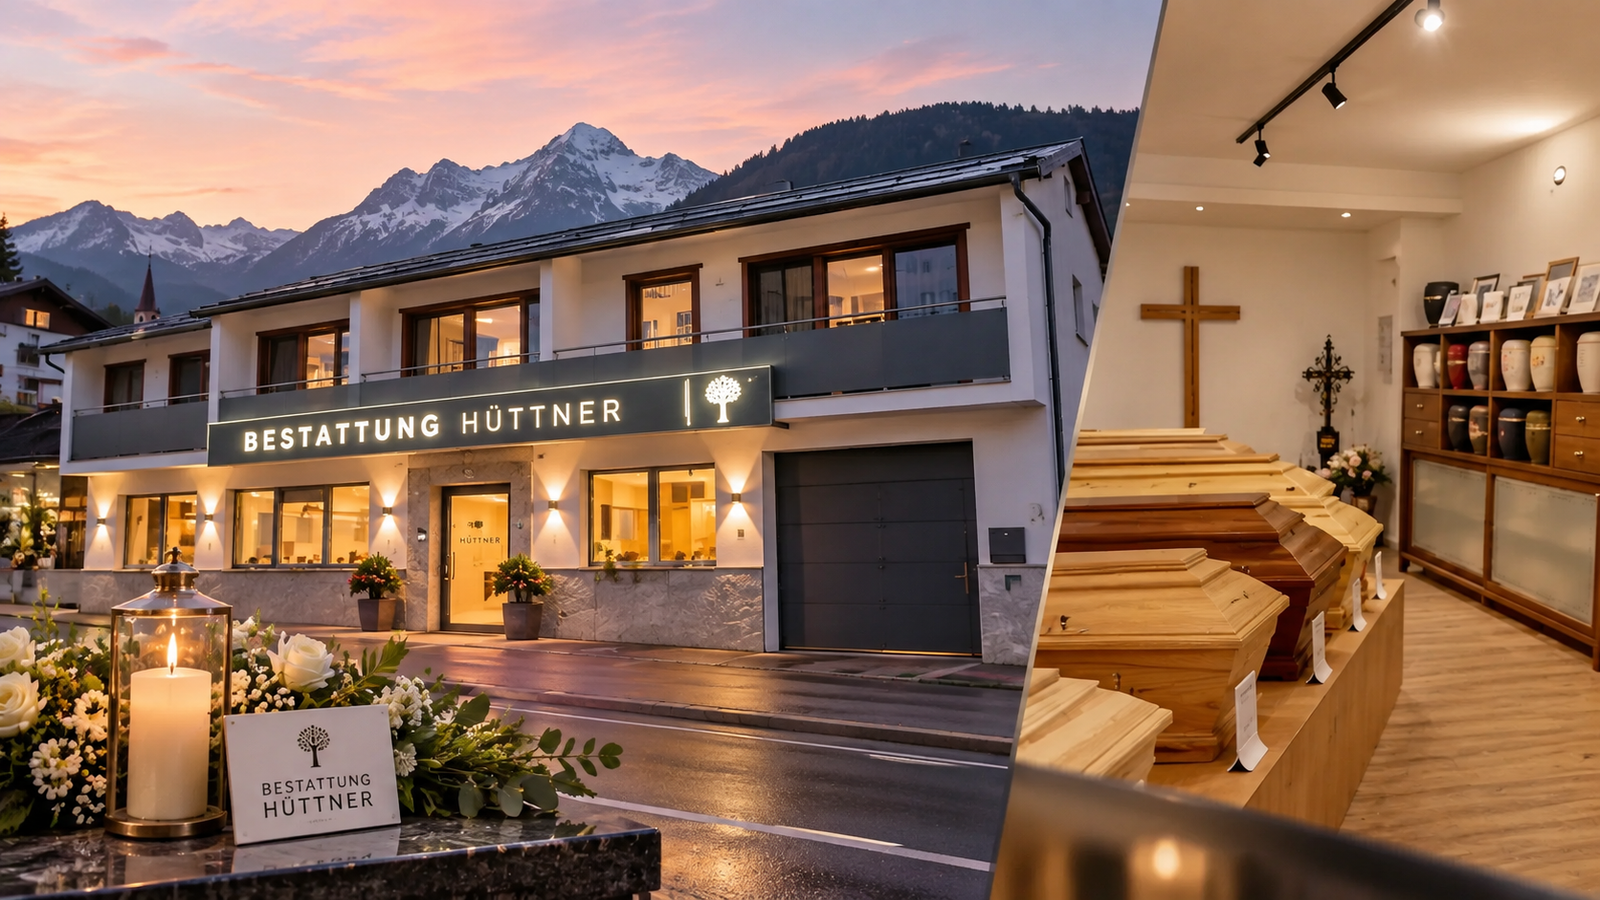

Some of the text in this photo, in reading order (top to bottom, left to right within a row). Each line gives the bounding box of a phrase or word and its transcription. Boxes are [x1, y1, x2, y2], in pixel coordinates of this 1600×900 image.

[244, 399, 621, 452] BESTATTUNG HÜTTNER
[262, 773, 371, 796] BESTATTUNG
[263, 790, 373, 818] HÜTTNER
